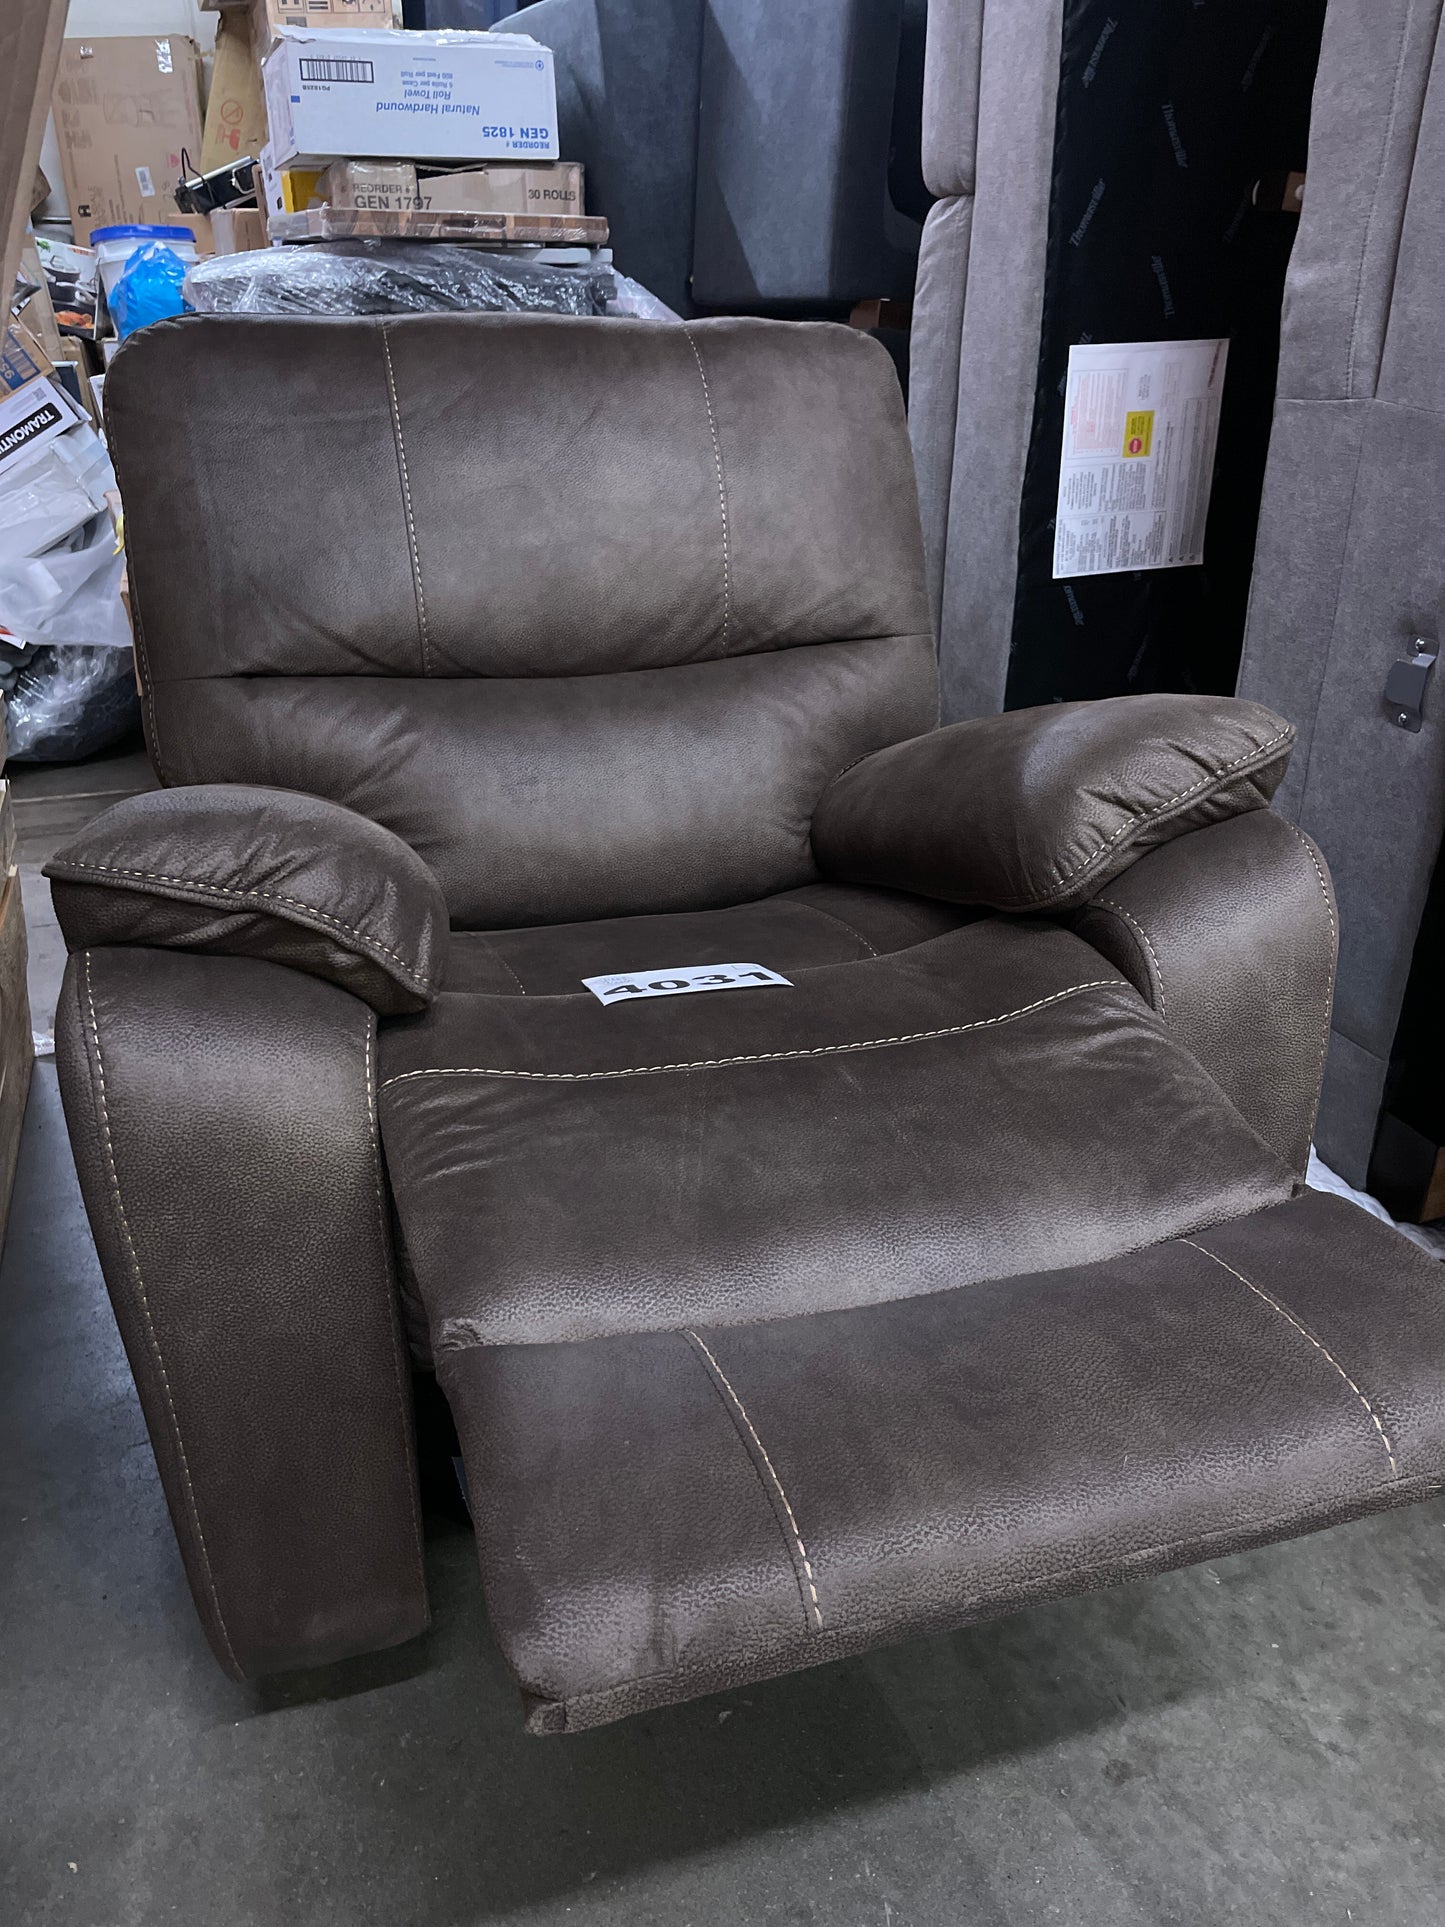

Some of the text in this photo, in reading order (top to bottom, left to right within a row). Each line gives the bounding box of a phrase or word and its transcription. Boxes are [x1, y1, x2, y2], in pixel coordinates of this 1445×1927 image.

[404, 88, 451, 100] Roll Towel
[376, 102, 480, 116] Natural Hardwound
[482, 126, 549, 140] GEN 1825
[512, 141, 550, 149] REORDER
[353, 184, 403, 194] REORDER
[528, 189, 576, 201] 30 ROLLS
[355, 195, 432, 210] GEN 1797
[0, 410, 54, 455] TRAMONTI
[603, 971, 774, 996] 4031
